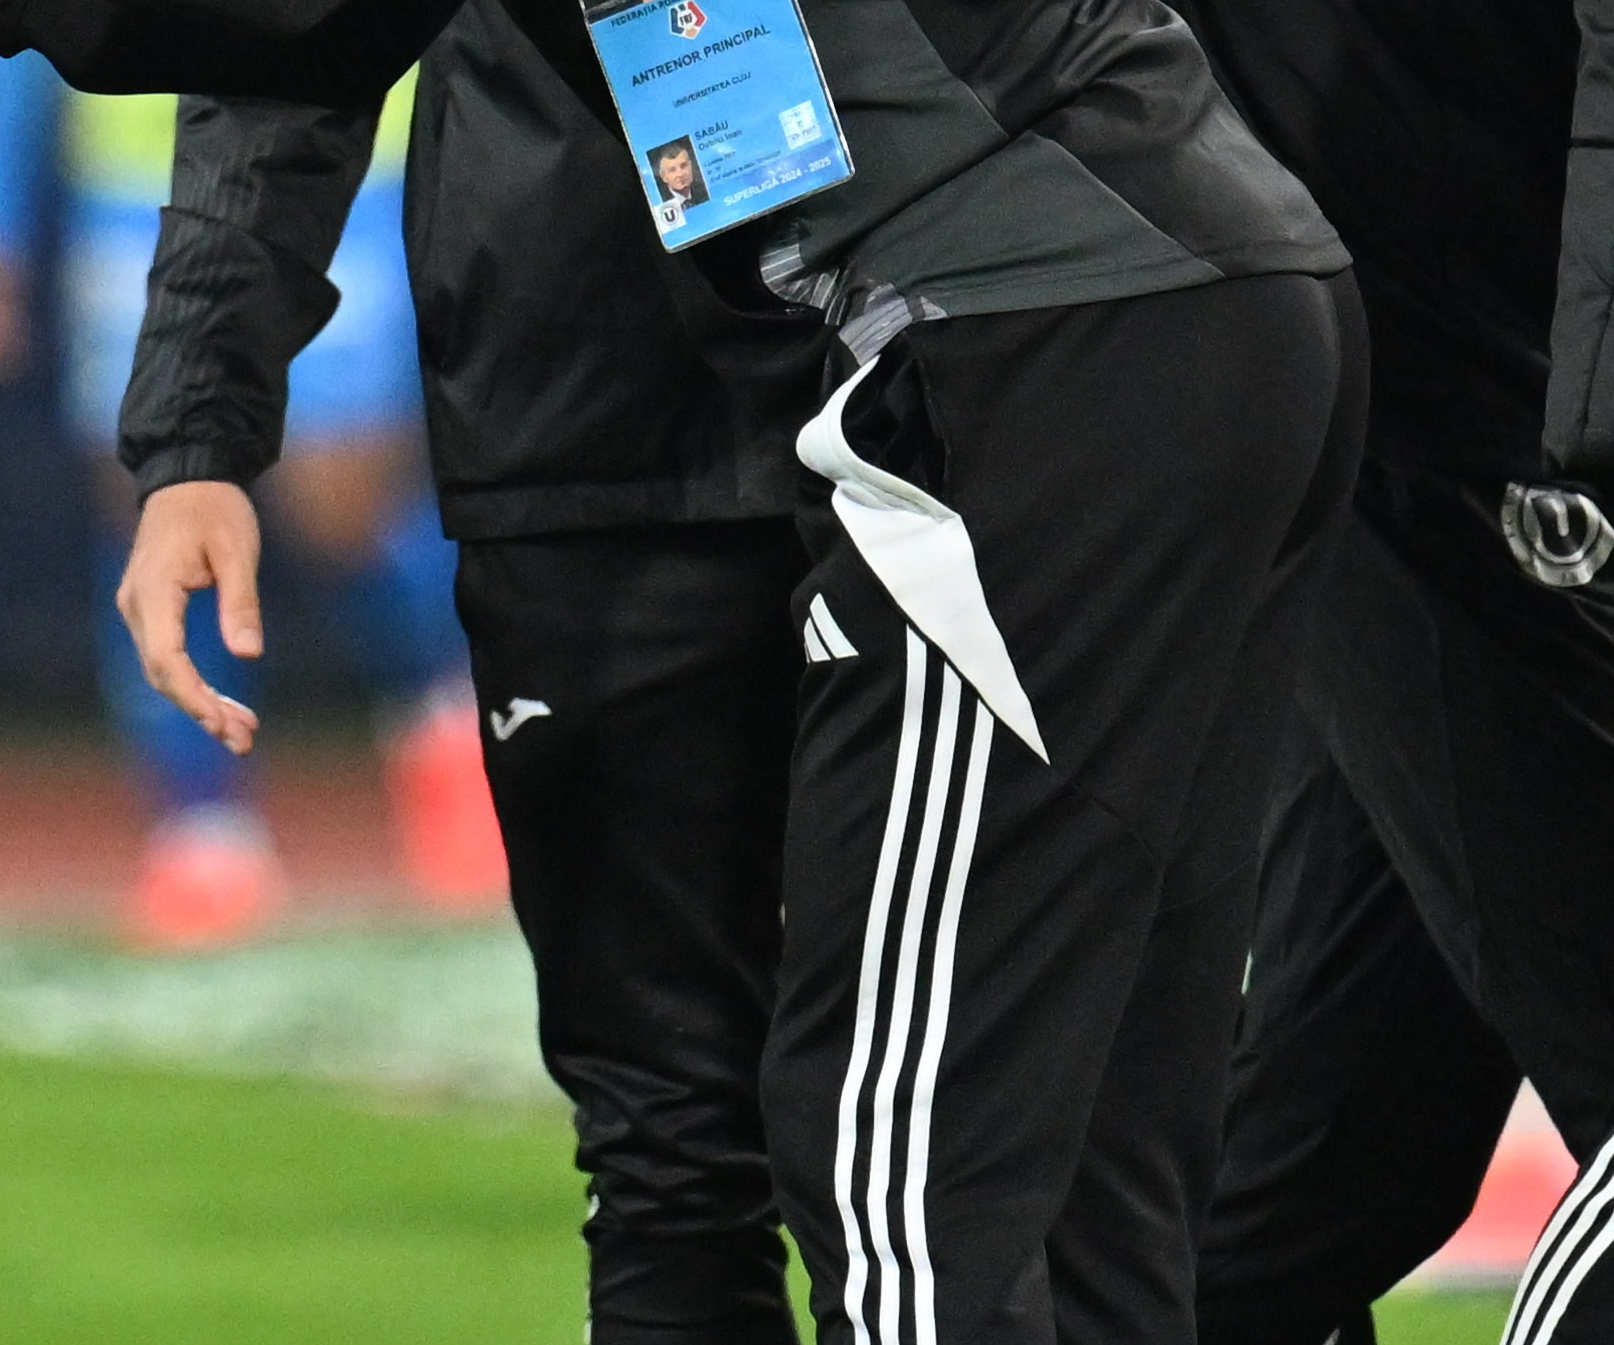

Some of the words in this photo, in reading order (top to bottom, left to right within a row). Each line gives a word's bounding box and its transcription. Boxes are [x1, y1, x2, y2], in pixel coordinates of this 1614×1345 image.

[632, 50, 702, 87] ANTRENOR
[703, 24, 771, 58] PRINCIPAL
[664, 209, 676, 222] U
